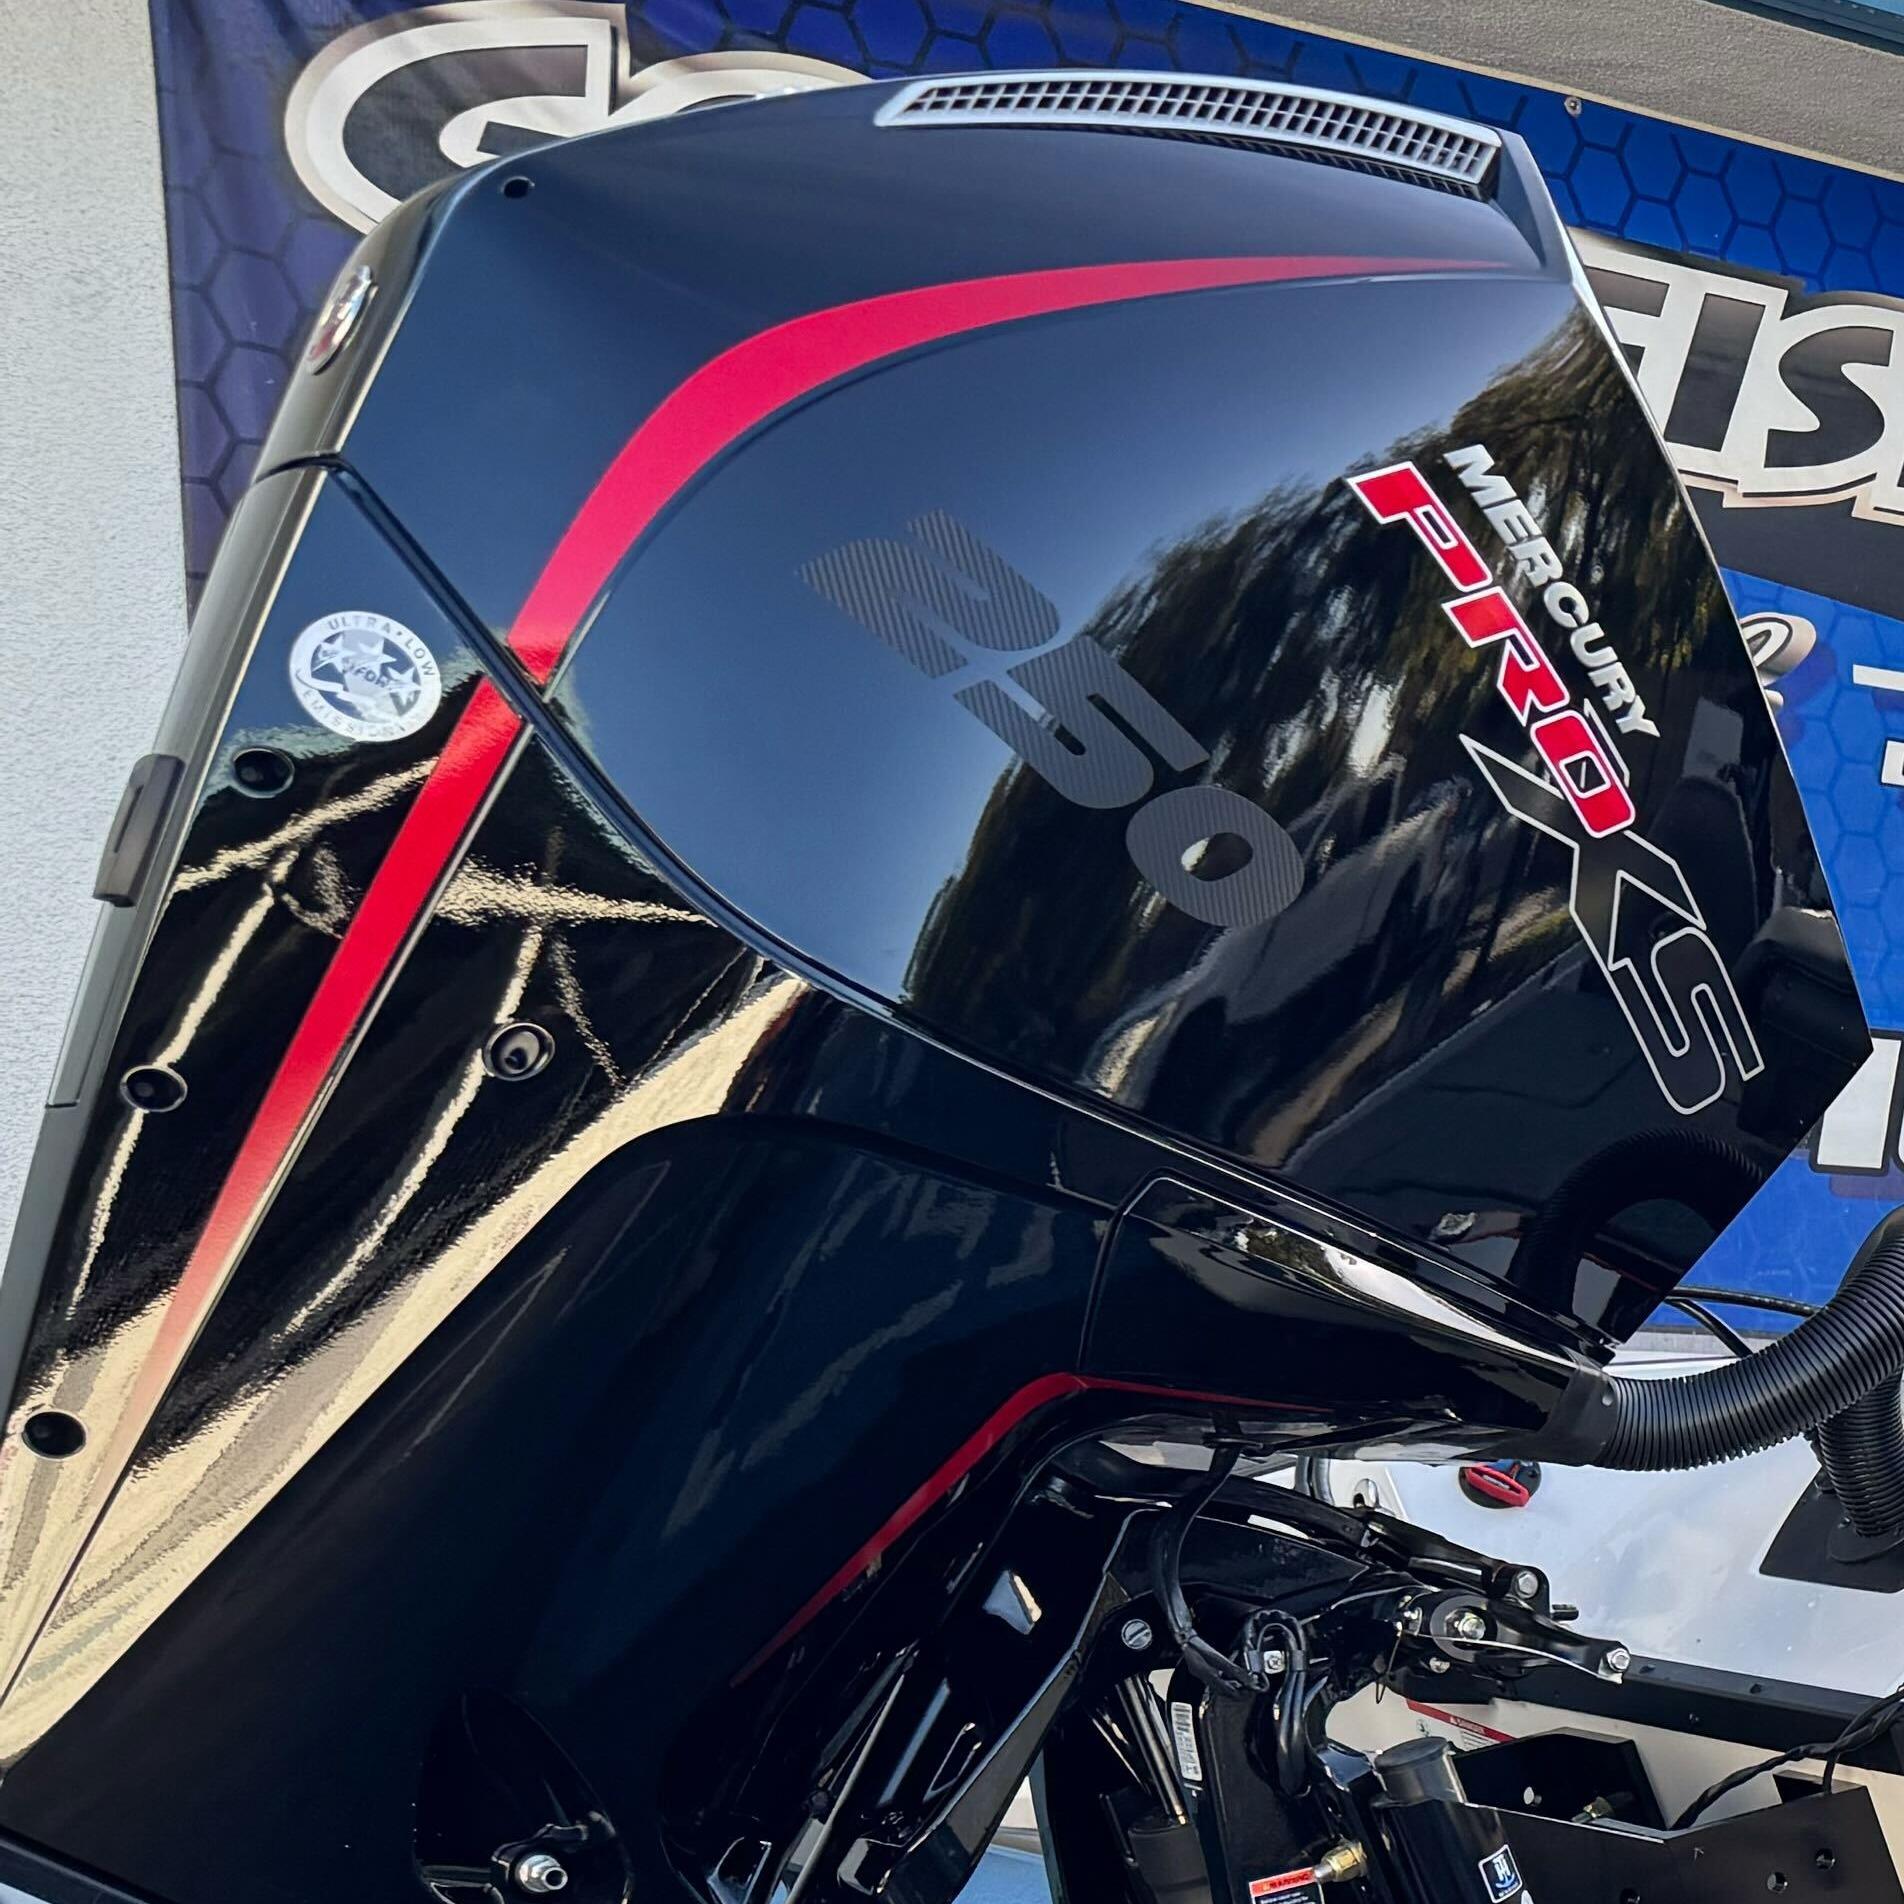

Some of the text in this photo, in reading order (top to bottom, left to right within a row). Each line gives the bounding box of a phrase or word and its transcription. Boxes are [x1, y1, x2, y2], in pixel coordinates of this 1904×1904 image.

[327, 616, 392, 635] ULTRA
[404, 637, 436, 676] LOW
[799, 507, 1305, 928] 250
[1347, 460, 1637, 839] PRO
[1443, 443, 1660, 740] MERCURY
[1458, 698, 1765, 1116] XS
